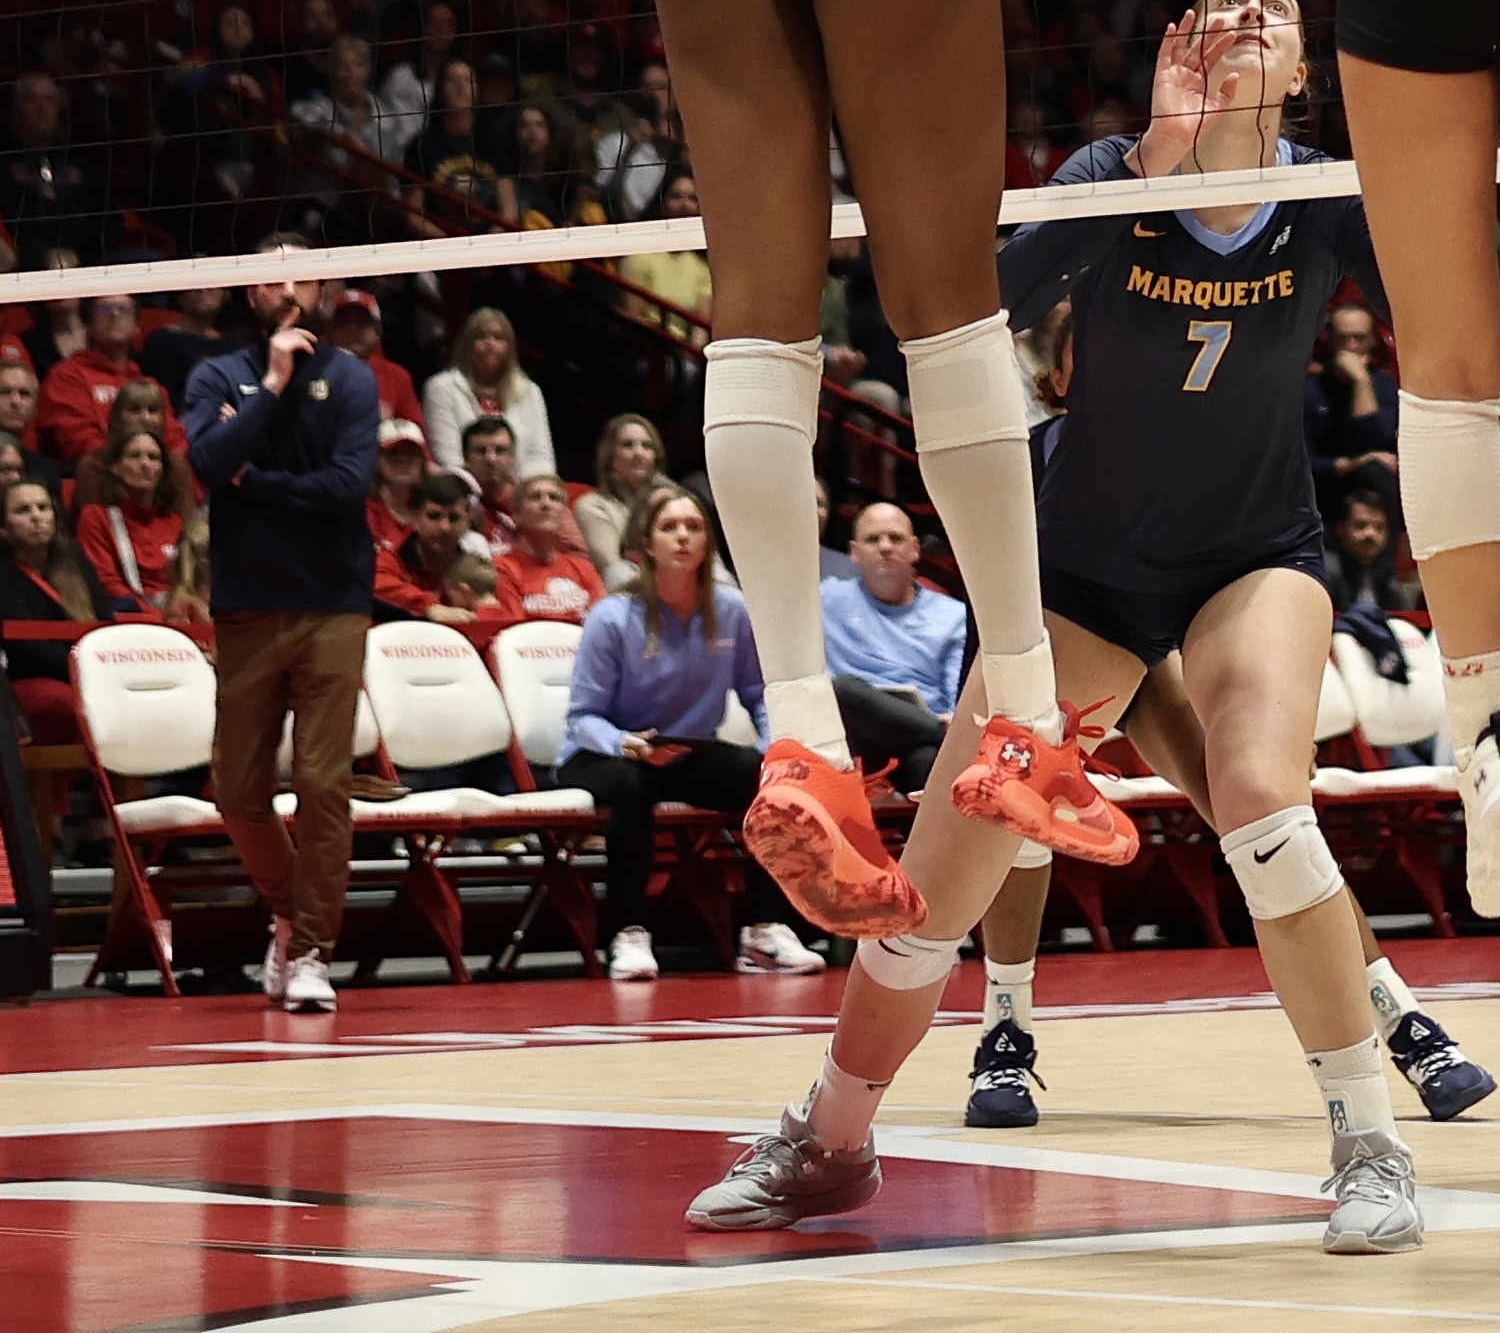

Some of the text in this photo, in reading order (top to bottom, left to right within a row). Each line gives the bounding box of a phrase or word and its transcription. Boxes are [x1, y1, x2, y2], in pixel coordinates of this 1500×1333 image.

[1126, 264, 1295, 310] MARQUETTE
[1181, 319, 1233, 392] 7
[95, 648, 197, 663] WISCONSIN
[379, 645, 473, 658] WISCONSIN
